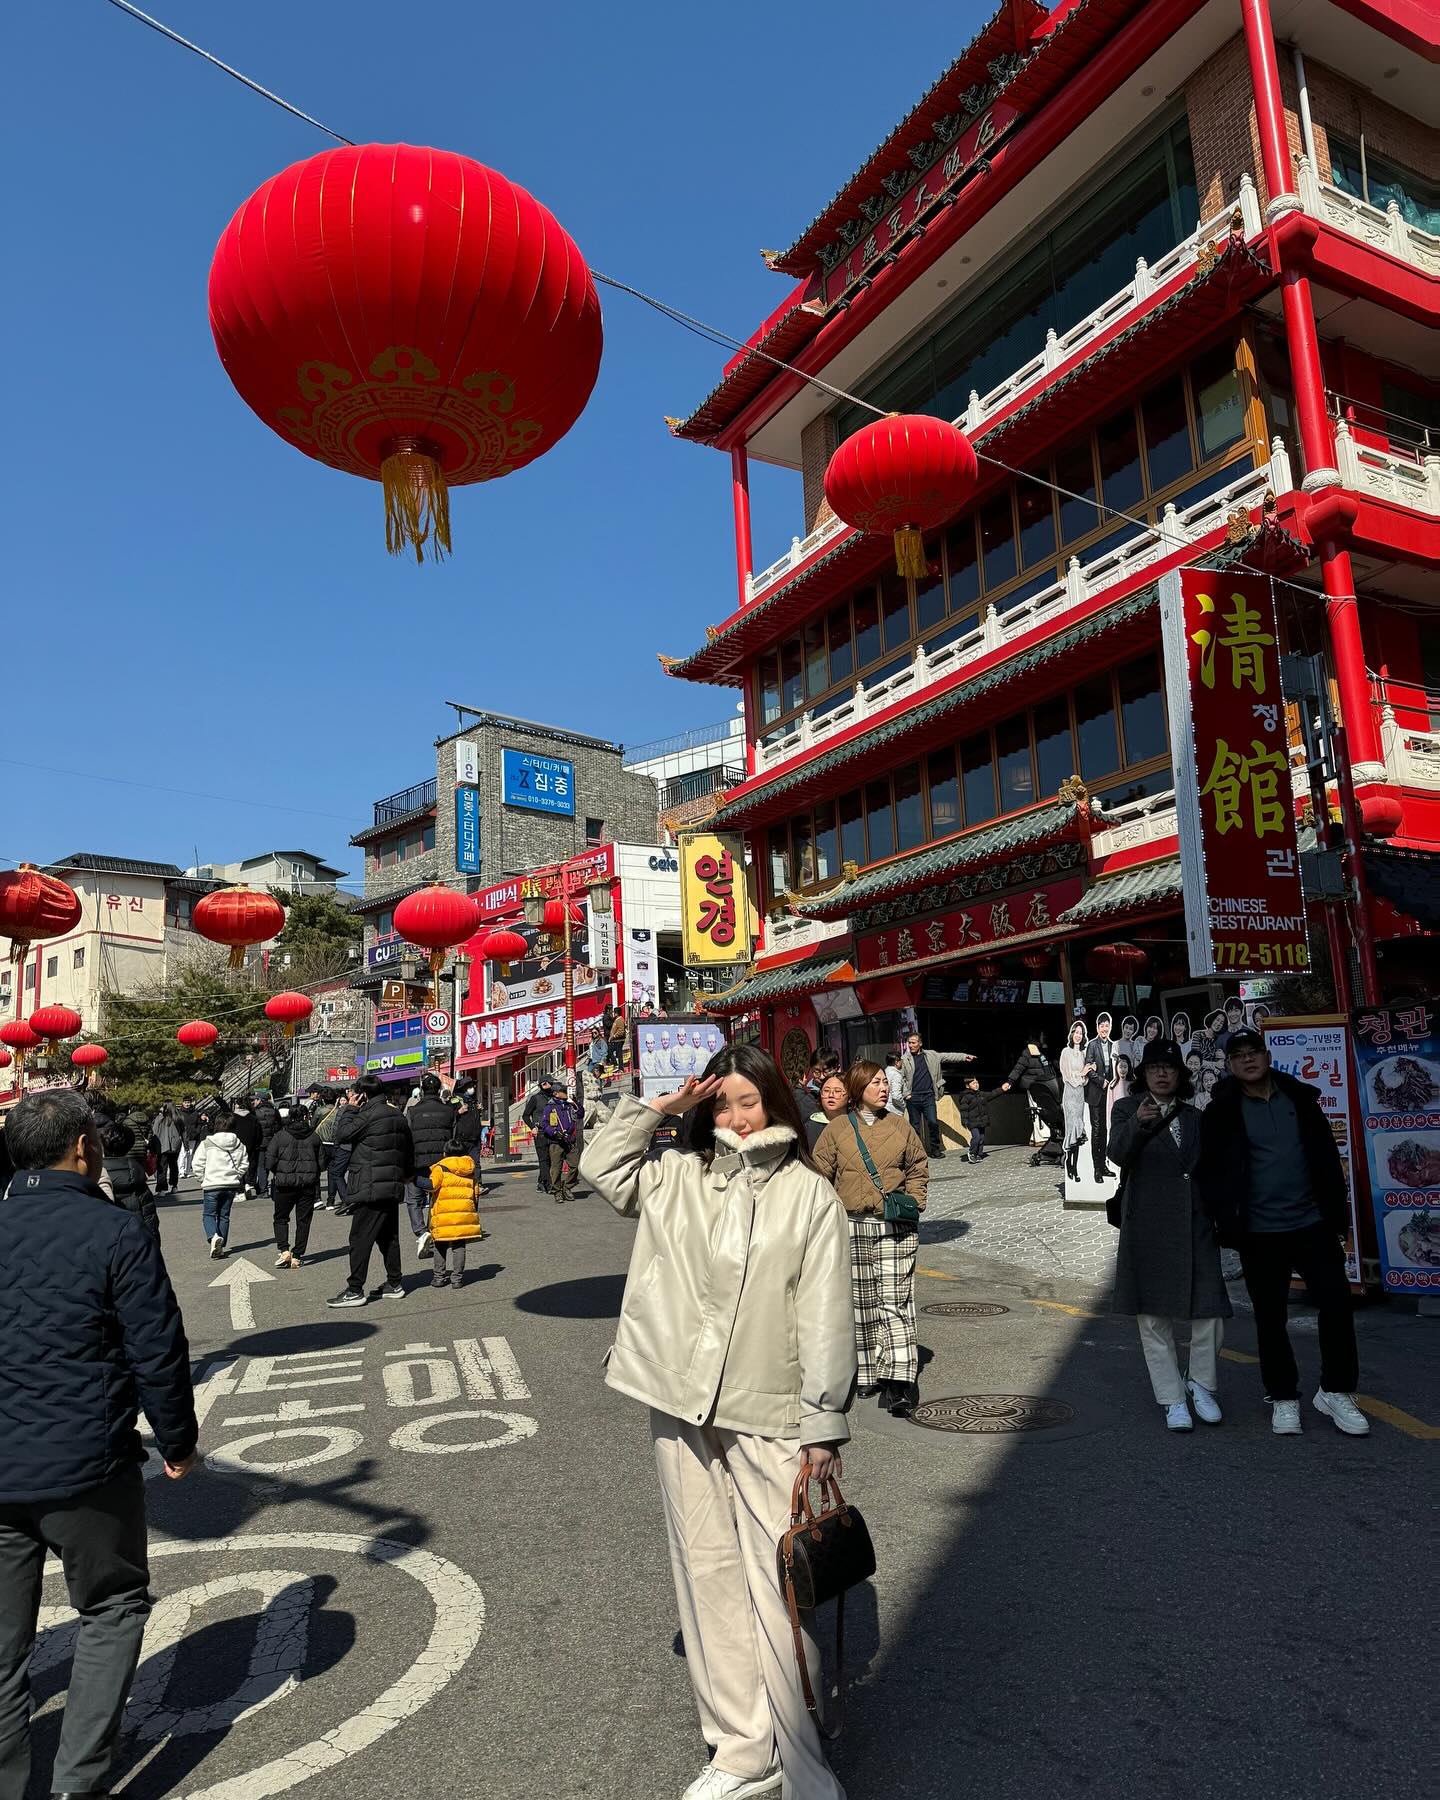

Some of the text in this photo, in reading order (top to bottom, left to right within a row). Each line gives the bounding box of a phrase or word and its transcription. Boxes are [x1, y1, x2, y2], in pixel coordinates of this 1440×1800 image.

[464, 790, 475, 862] 집중스터디카페
[649, 855, 679, 872] Cafe
[106, 893, 144, 913] 유신
[694, 850, 736, 945] 연경
[1209, 897, 1304, 932] CHINESE RESTAURANT
[600, 921, 610, 966] 커피전문점
[376, 945, 390, 962] CU
[1213, 942, 1309, 967] 772-5118
[391, 985, 401, 997] P
[430, 1015, 446, 1027] 30
[1269, 1035, 1295, 1046] KBS
[381, 1055, 394, 1069] CU
